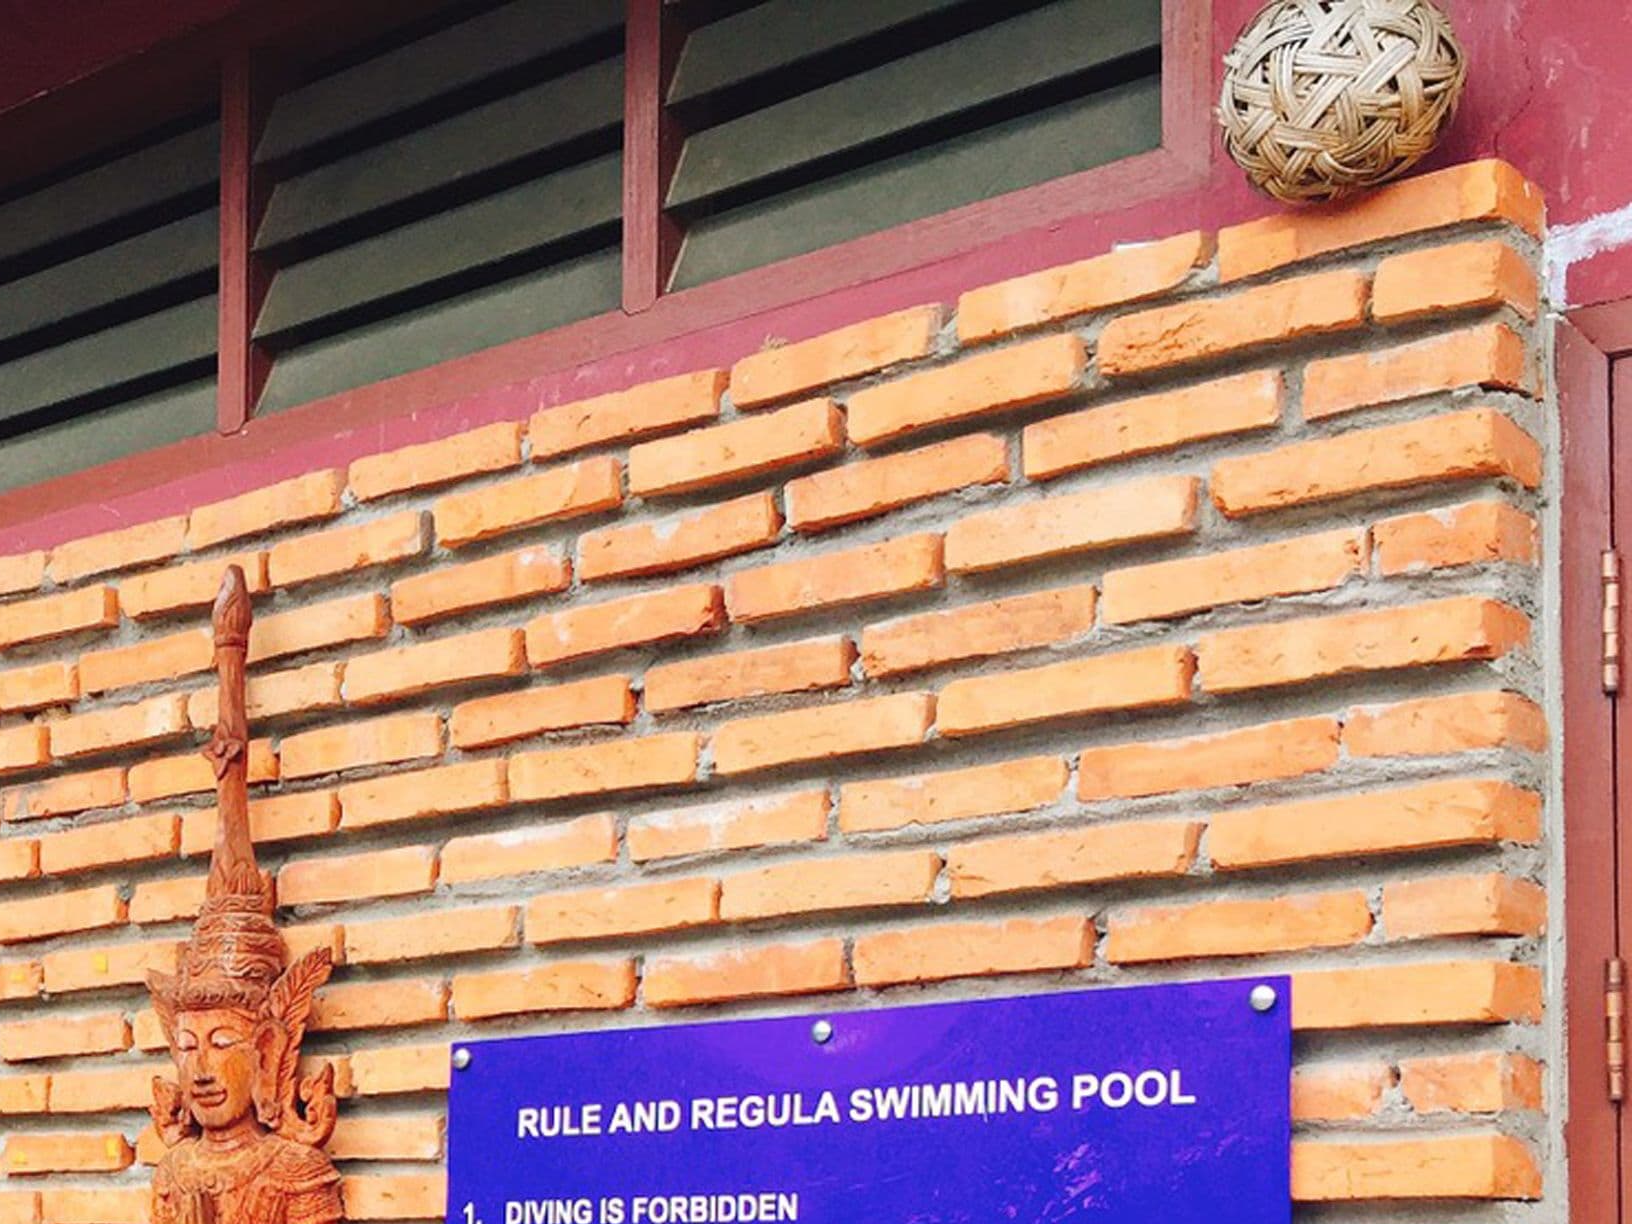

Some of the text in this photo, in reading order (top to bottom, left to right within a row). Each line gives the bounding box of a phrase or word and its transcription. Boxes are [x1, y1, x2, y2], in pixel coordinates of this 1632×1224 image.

[517, 1069, 1197, 1139] RULE AND REGULA SWIMMING POOL
[599, 1197, 625, 1224] IS
[631, 1192, 798, 1224] FORBIDDEN
